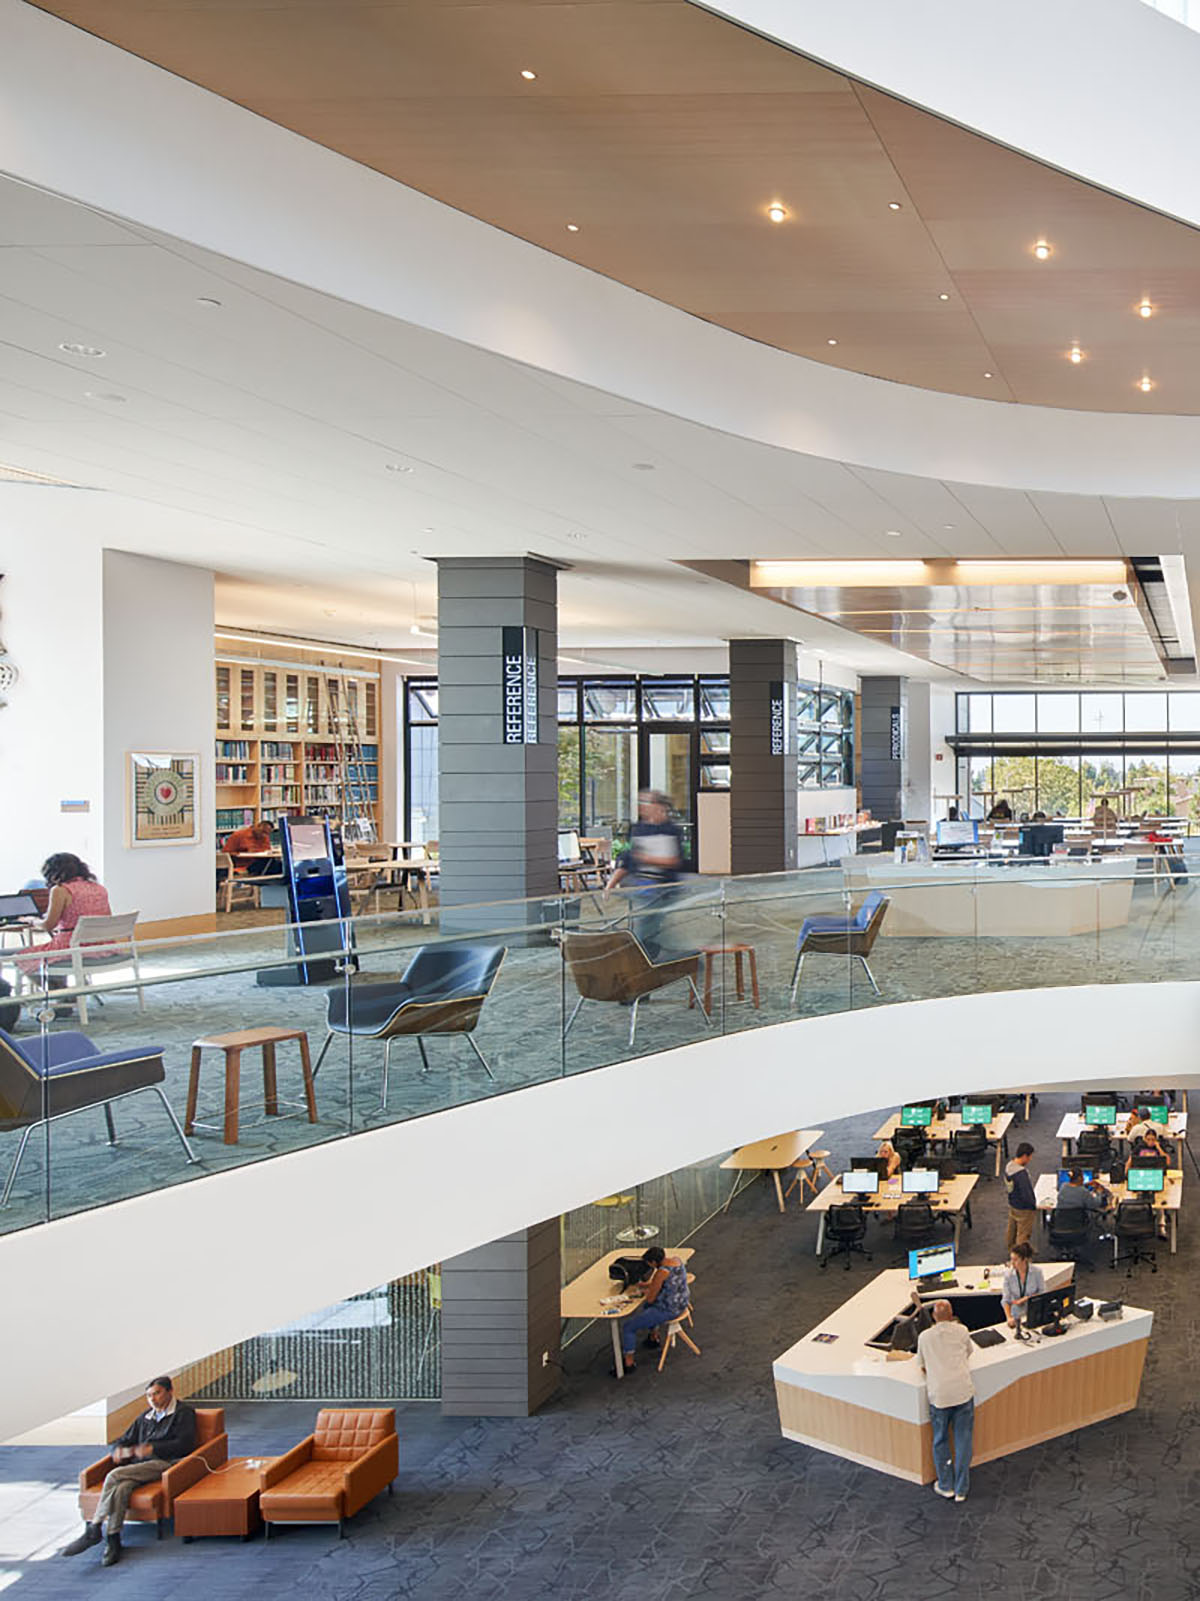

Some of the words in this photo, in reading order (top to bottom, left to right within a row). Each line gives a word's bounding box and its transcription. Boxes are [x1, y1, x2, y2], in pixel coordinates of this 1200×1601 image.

[506, 655, 522, 744] REFERENCE
[527, 656, 537, 744] REFERENCE
[772, 699, 782, 755] REFERENCE
